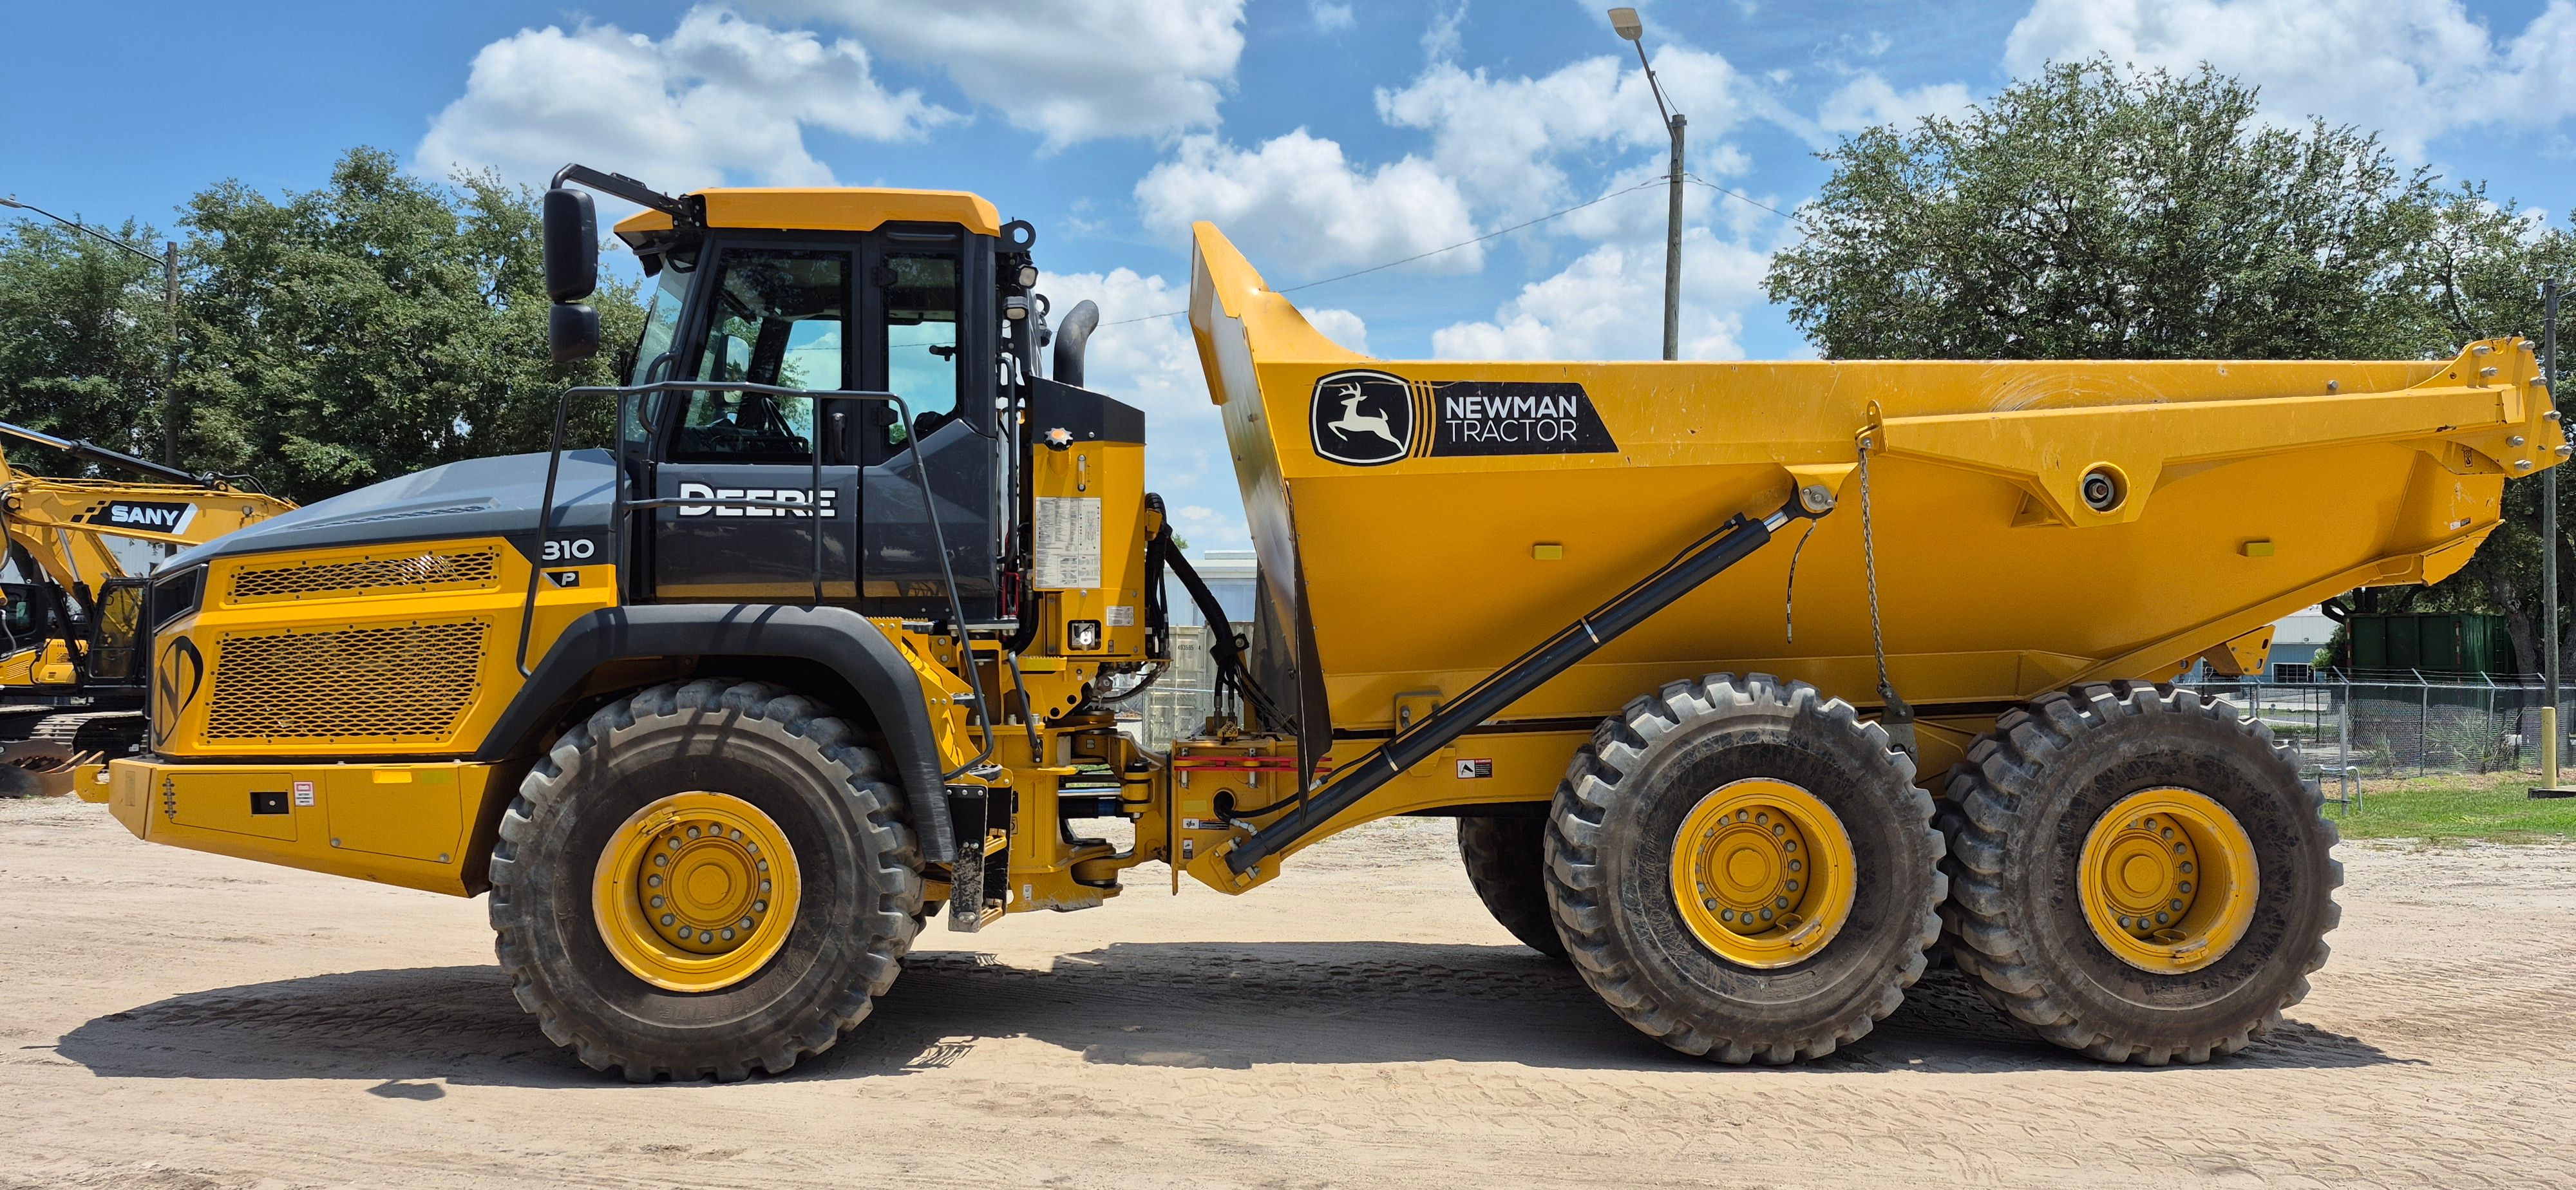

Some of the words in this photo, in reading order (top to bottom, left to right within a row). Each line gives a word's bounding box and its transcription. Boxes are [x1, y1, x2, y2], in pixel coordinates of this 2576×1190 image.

[1446, 395, 1577, 419] NEWMAN
[1445, 419, 1577, 442] TRACTOR
[679, 483, 836, 516] DEERE
[111, 505, 179, 526] SANY
[542, 539, 594, 560] 310
[561, 572, 576, 585] P
